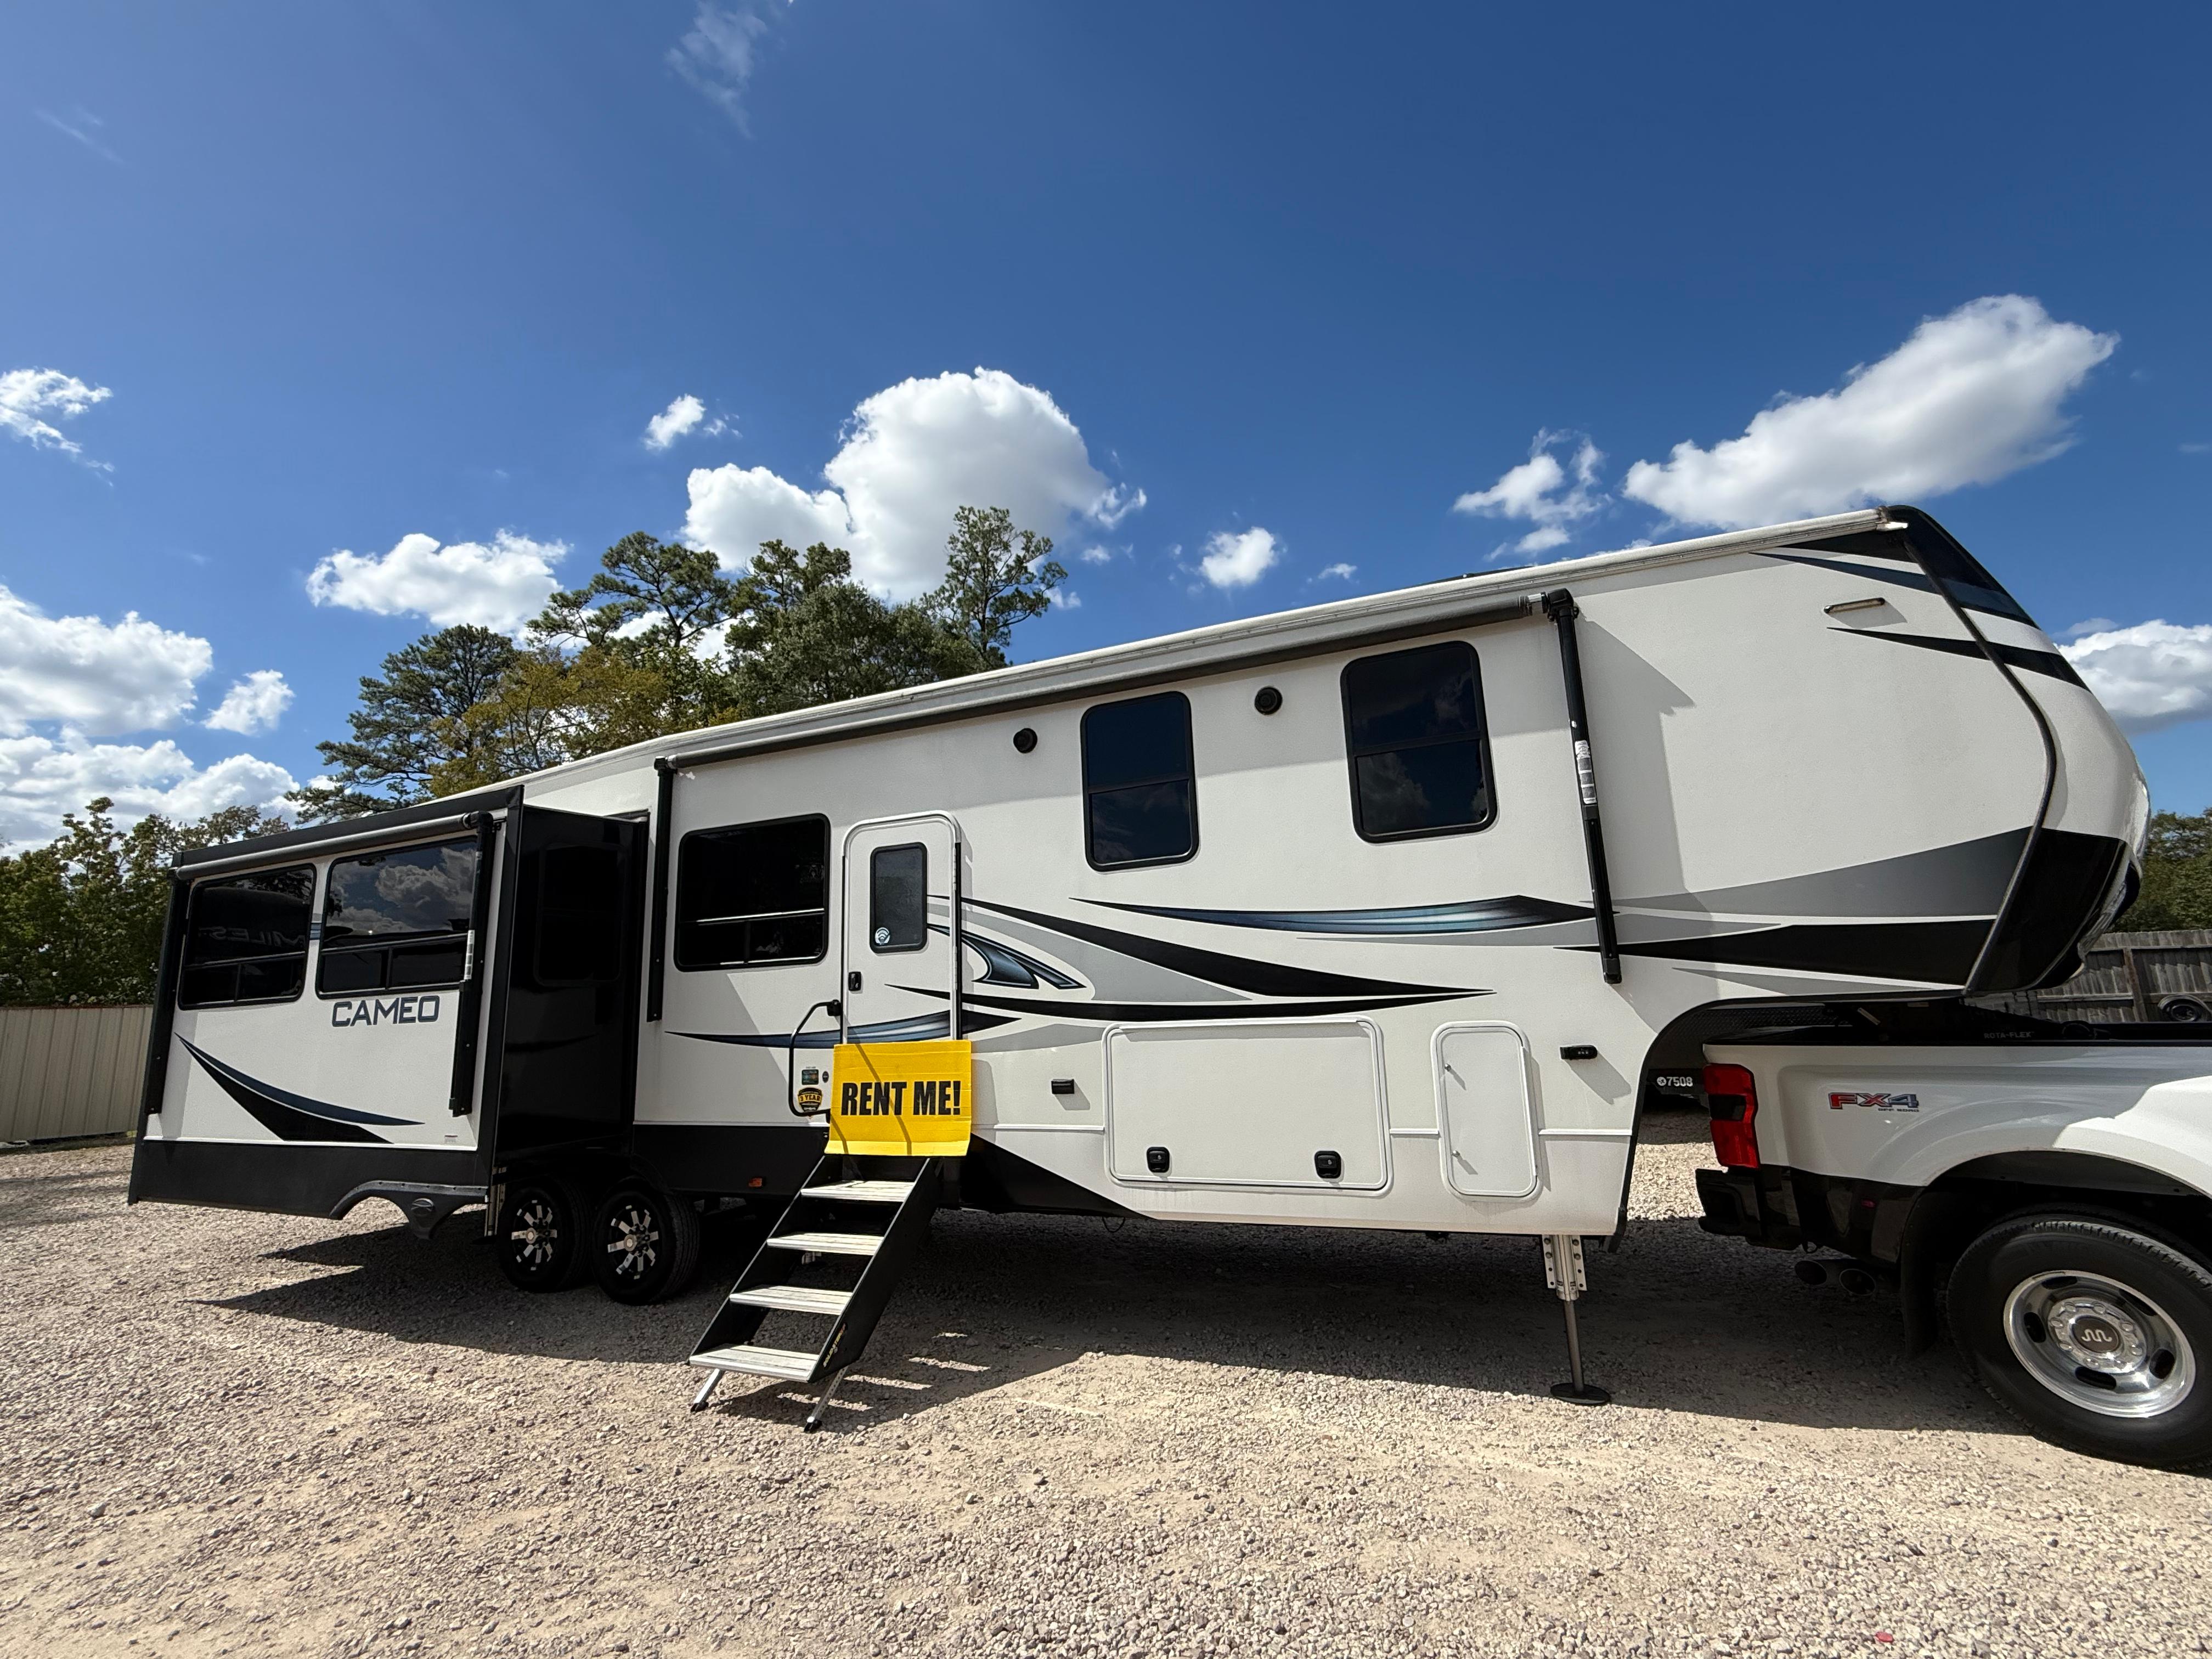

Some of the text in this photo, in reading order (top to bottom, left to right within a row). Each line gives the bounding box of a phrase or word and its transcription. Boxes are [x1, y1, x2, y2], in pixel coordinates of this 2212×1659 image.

[332, 996, 440, 1027] CAMEO
[1667, 1076, 1693, 1087] 7508
[841, 1081, 961, 1115] RENT ME!
[1829, 1092, 1919, 1109] FX4
